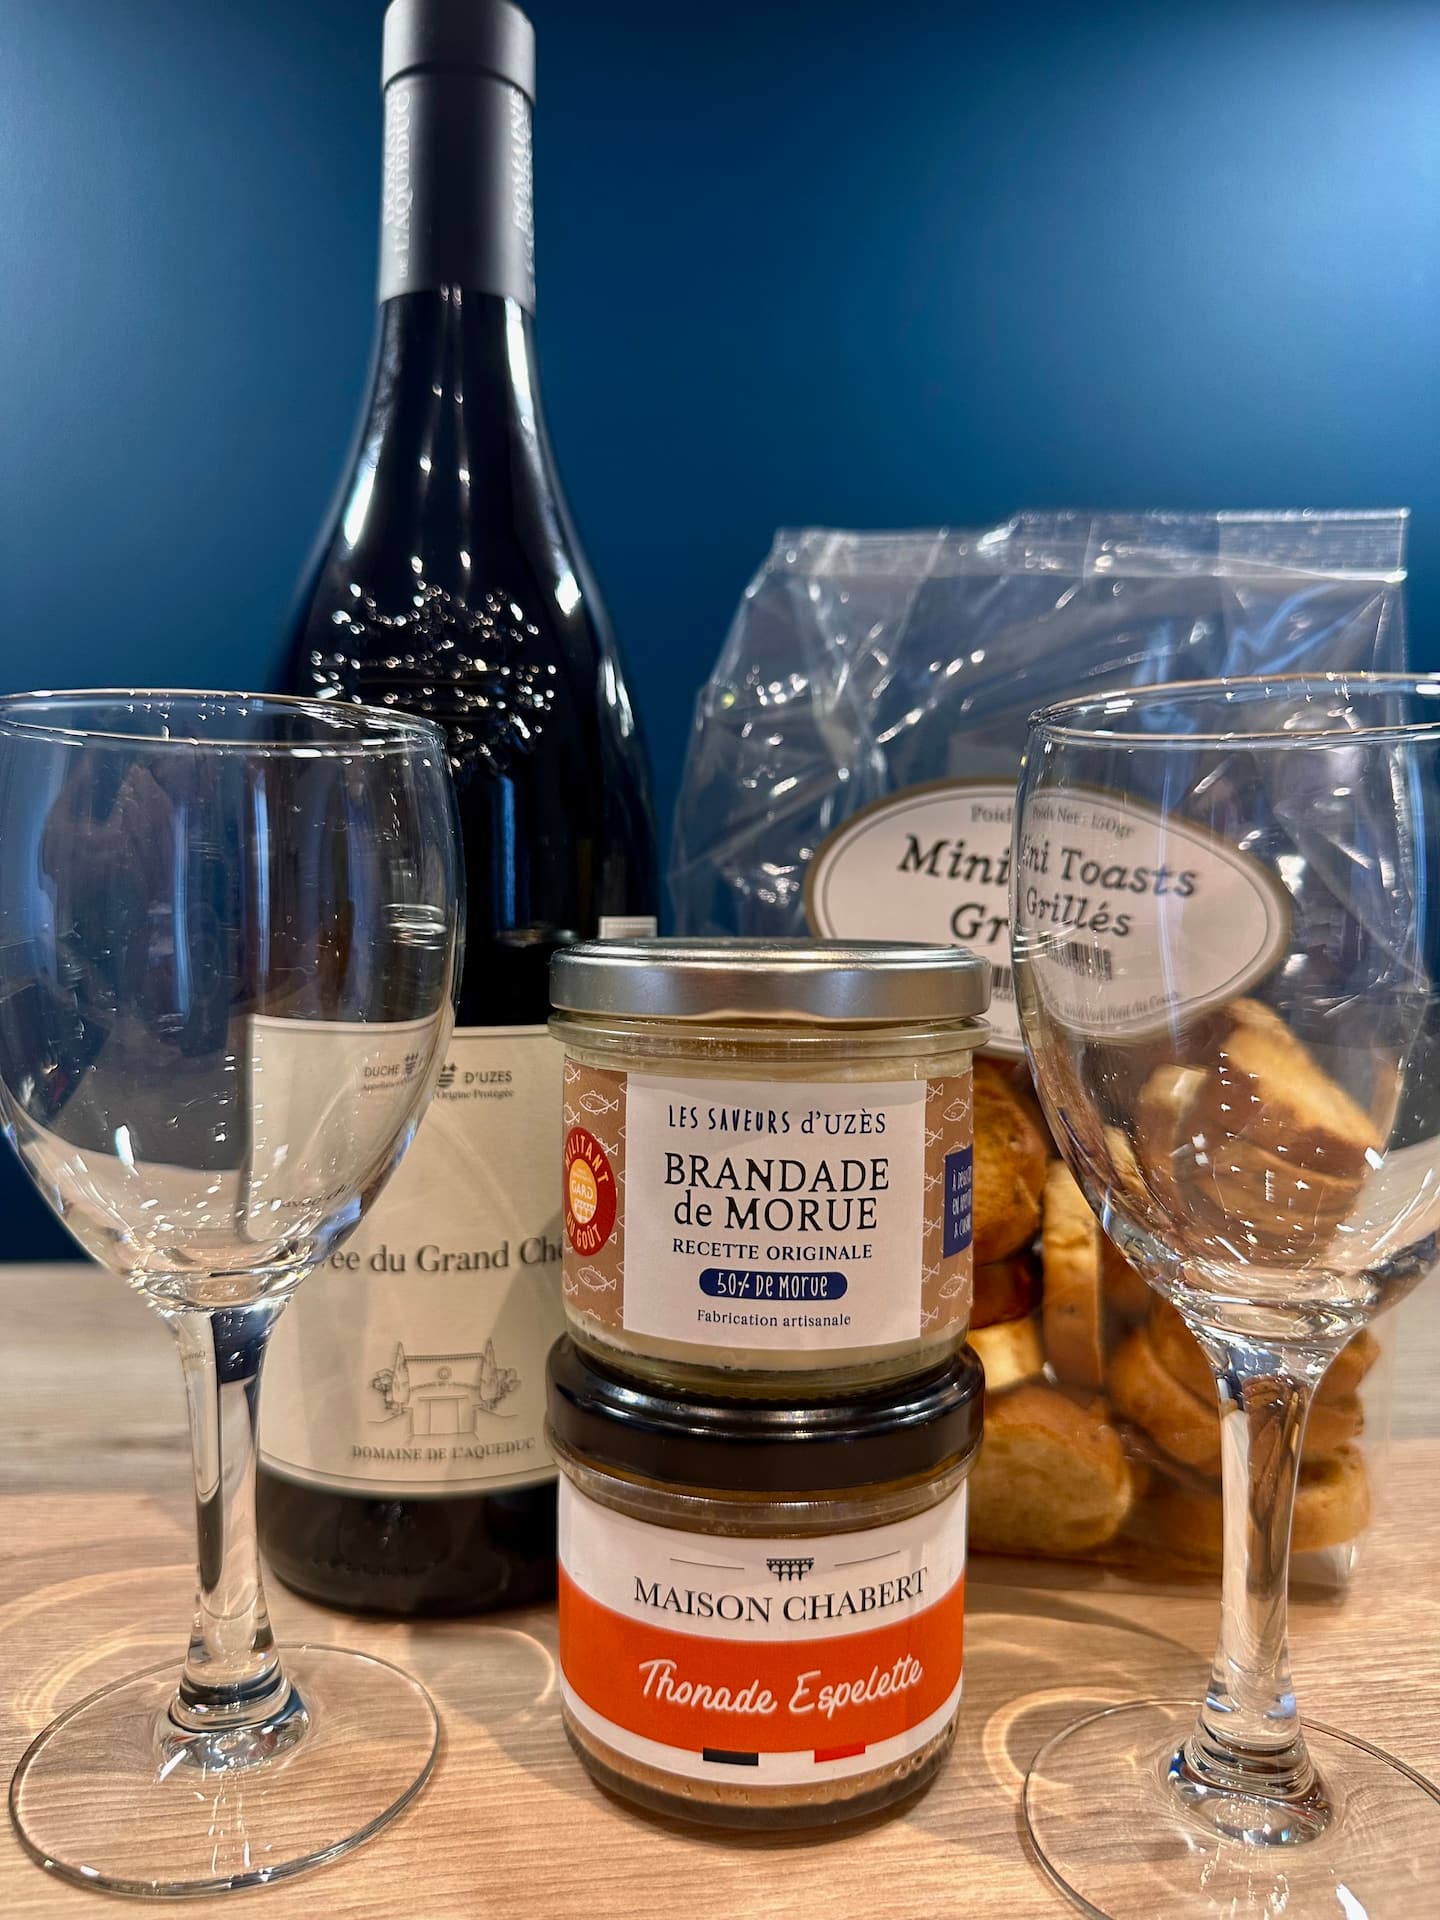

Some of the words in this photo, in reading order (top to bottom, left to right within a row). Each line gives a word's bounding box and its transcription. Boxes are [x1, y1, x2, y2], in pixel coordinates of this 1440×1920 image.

[970, 804, 1013, 824] Poid
[1061, 847, 1198, 898] Toasts
[1026, 886, 1132, 938] Grillés
[464, 1071, 513, 1084] D'UZES
[668, 1104, 698, 1130] LES
[708, 1107, 791, 1135] SAVEURS
[801, 1109, 886, 1135] d'UZÈS
[664, 1152, 890, 1193] BRANDADE
[673, 1190, 713, 1228] de
[726, 1196, 878, 1232] MORUE
[370, 1244, 406, 1272] du
[416, 1240, 509, 1273] Grand
[672, 1238, 759, 1261] RECETTE
[766, 1244, 873, 1262] ORIGINALE
[697, 1309, 778, 1329] Fabrication
[783, 1313, 852, 1328] artisanale
[351, 1443, 423, 1461] DOMAINE
[427, 1447, 448, 1460] DE
[452, 1436, 537, 1460] L'AQUEDUC
[634, 1576, 773, 1624] MAISON
[783, 1567, 928, 1622] CHABERT
[639, 1658, 778, 1714] Thonade
[788, 1653, 923, 1720] Espelette
